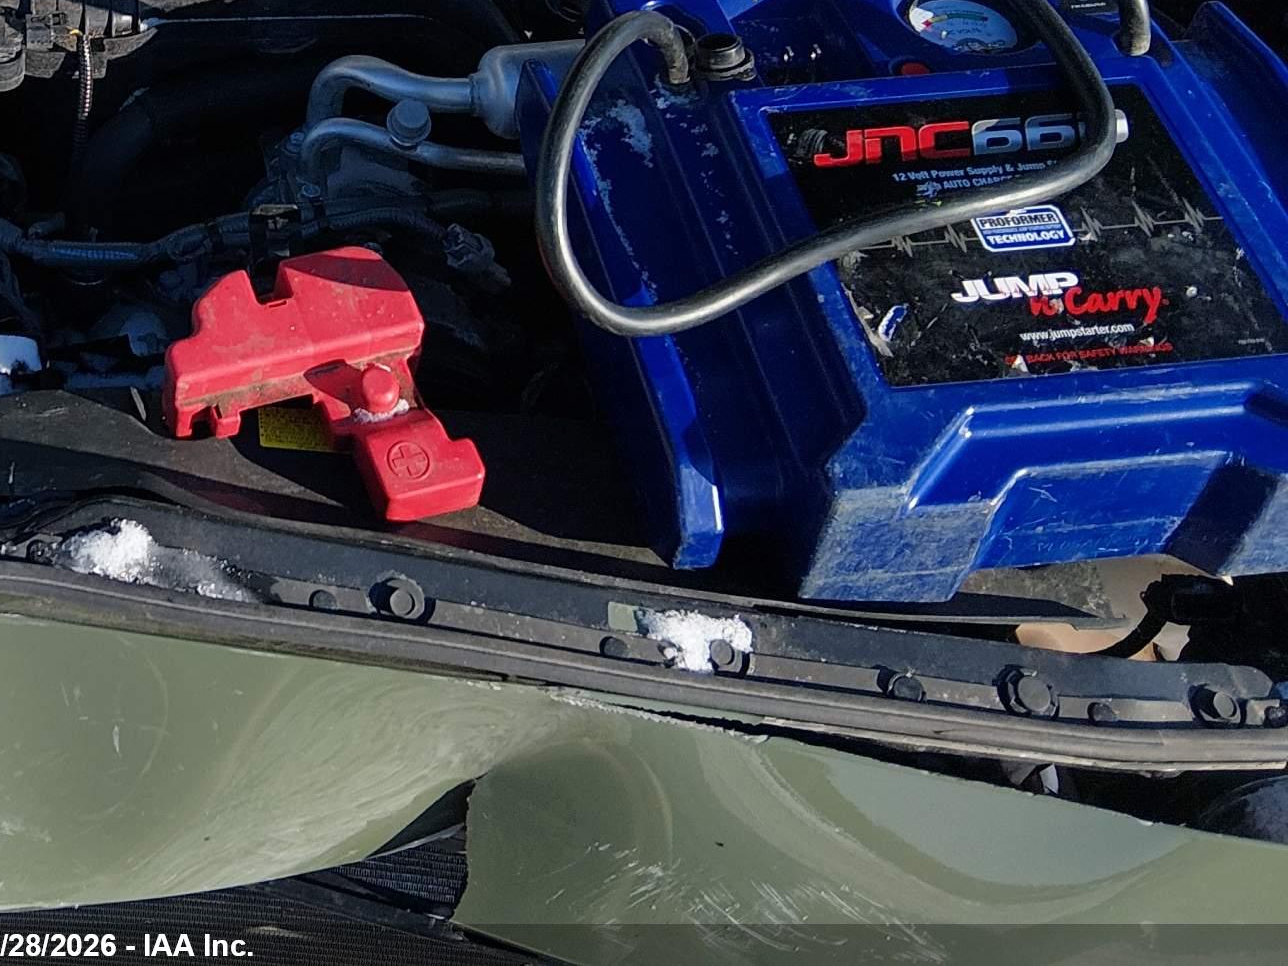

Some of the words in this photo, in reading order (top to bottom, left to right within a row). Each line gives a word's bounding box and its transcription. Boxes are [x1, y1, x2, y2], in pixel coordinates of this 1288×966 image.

[892, 172, 907, 182] 12
[907, 170, 929, 181] Volt
[930, 168, 965, 180] Power
[966, 163, 1004, 176] Supply
[1005, 163, 1015, 172] &
[943, 178, 971, 189] AUTO
[979, 212, 1058, 229] PROFORMER
[985, 229, 1066, 246] TECHNOLOGY
[951, 272, 1078, 303] JUMP
[1019, 322, 1136, 342] www.jumpstarter.com
[1025, 353, 1055, 364] BACK
[1056, 350, 1078, 362] FOR
[1079, 345, 1117, 360] SAFETY
